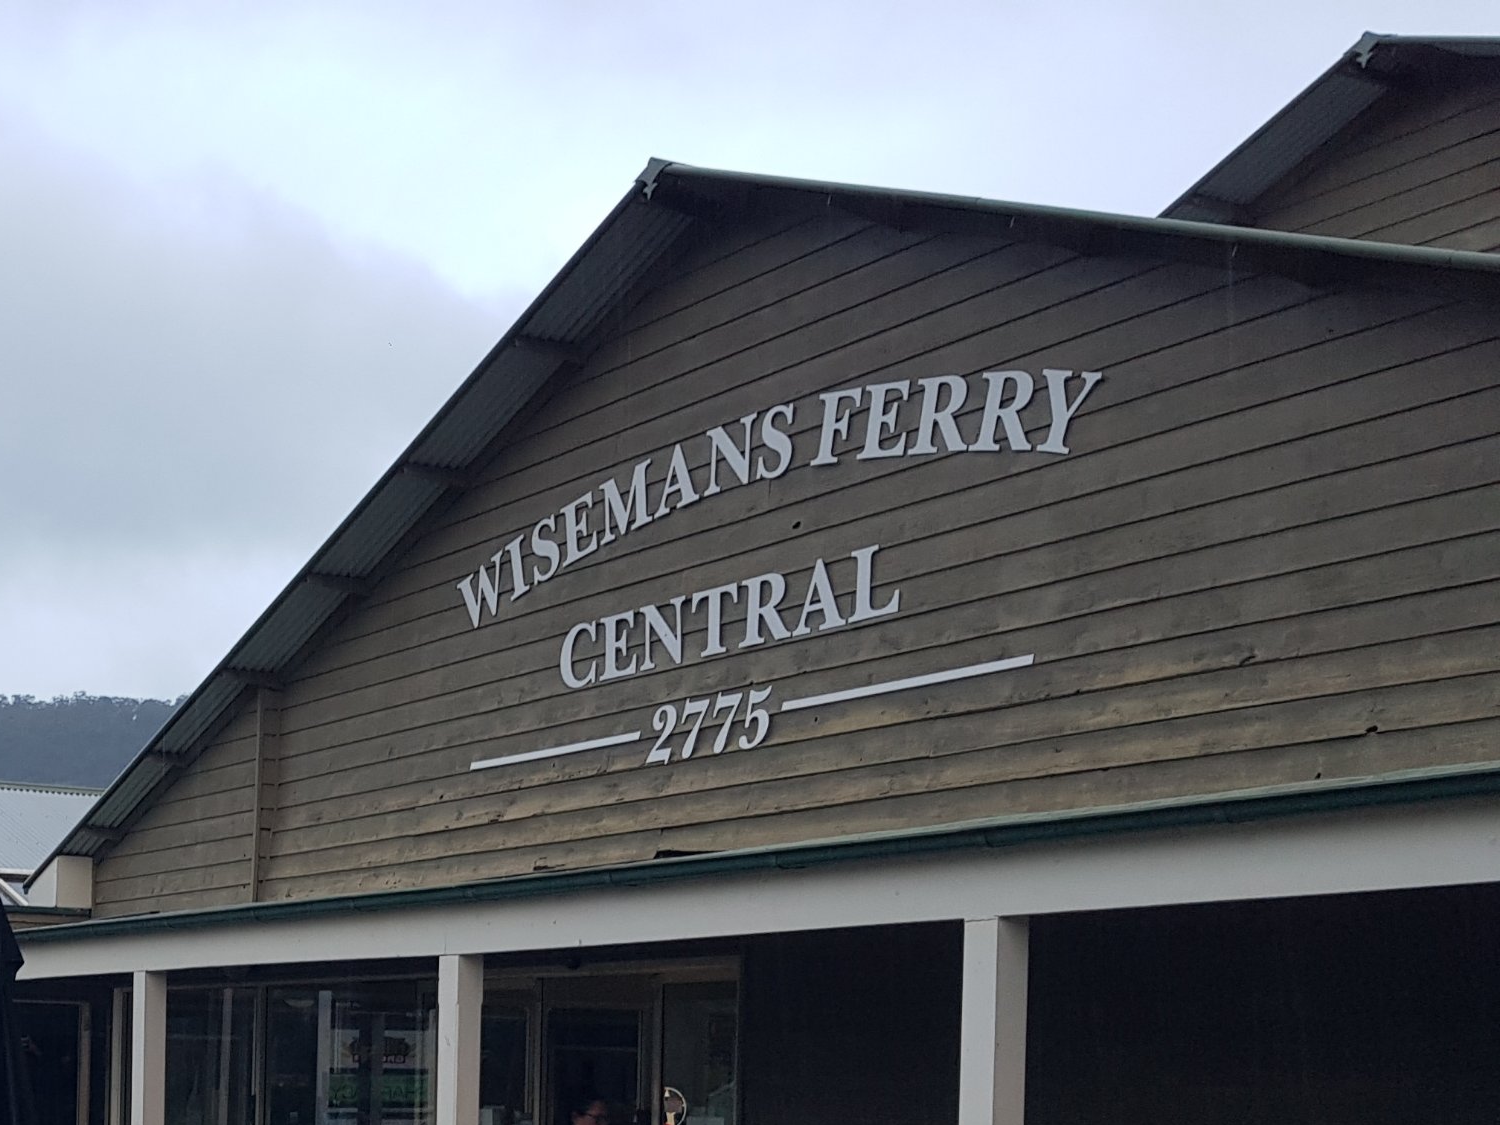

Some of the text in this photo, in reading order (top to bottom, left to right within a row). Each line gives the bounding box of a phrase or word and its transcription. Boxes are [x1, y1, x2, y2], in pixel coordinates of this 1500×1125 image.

[456, 367, 1104, 629] WISEMANS FERRY
[559, 543, 901, 690] CENTRAL
[645, 684, 773, 766] 2775
